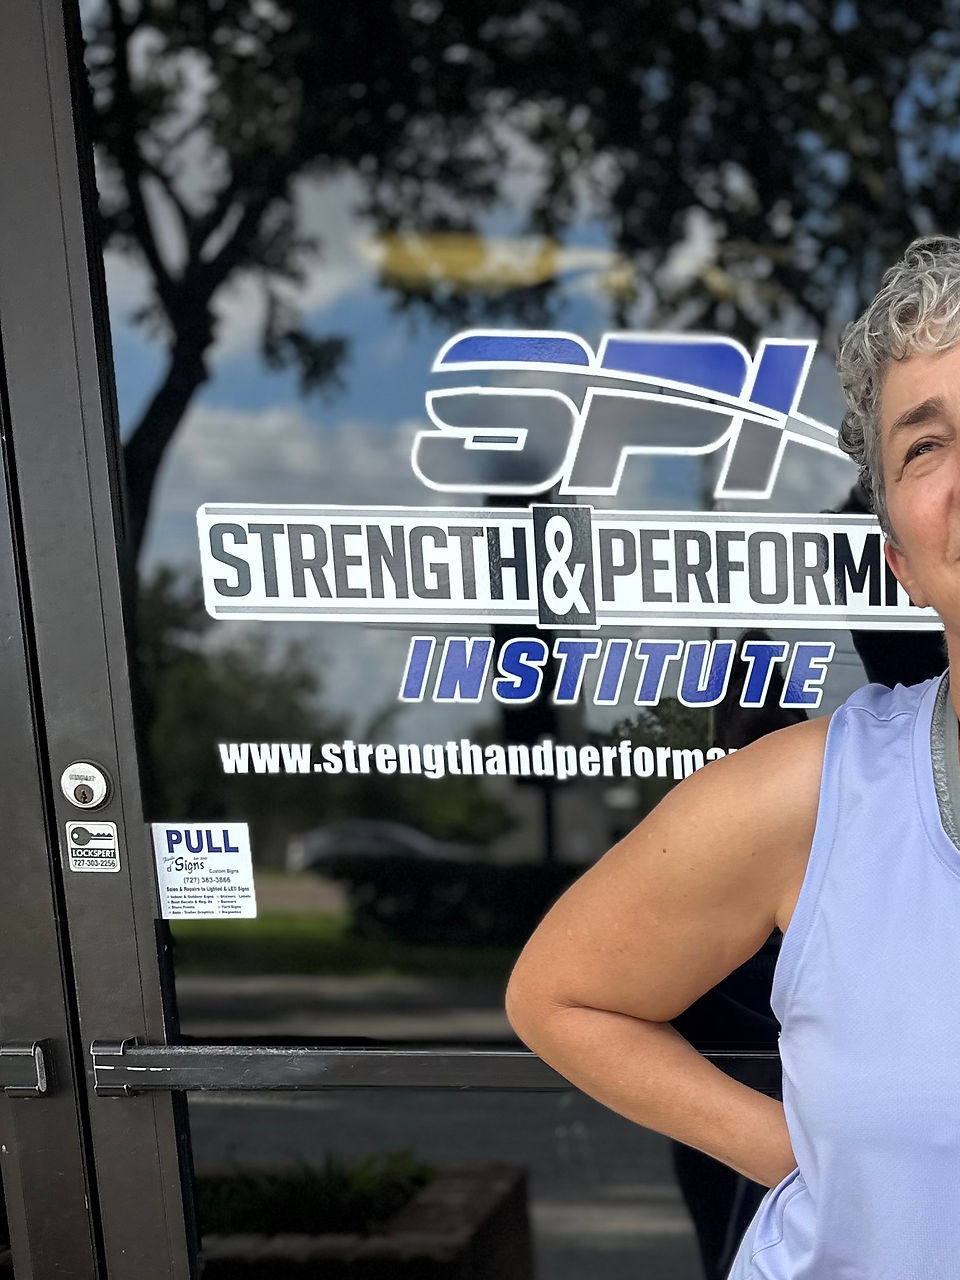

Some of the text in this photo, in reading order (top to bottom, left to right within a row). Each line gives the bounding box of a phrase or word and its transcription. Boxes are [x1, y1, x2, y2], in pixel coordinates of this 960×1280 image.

[411, 329, 818, 500] SPI
[208, 514, 916, 617] STRENGTH & PERFORM
[399, 636, 836, 709] INSTITUTE
[218, 738, 738, 780] www.strengthandperform
[72, 849, 115, 858] LOCKSPERT
[165, 829, 239, 854] PULL
